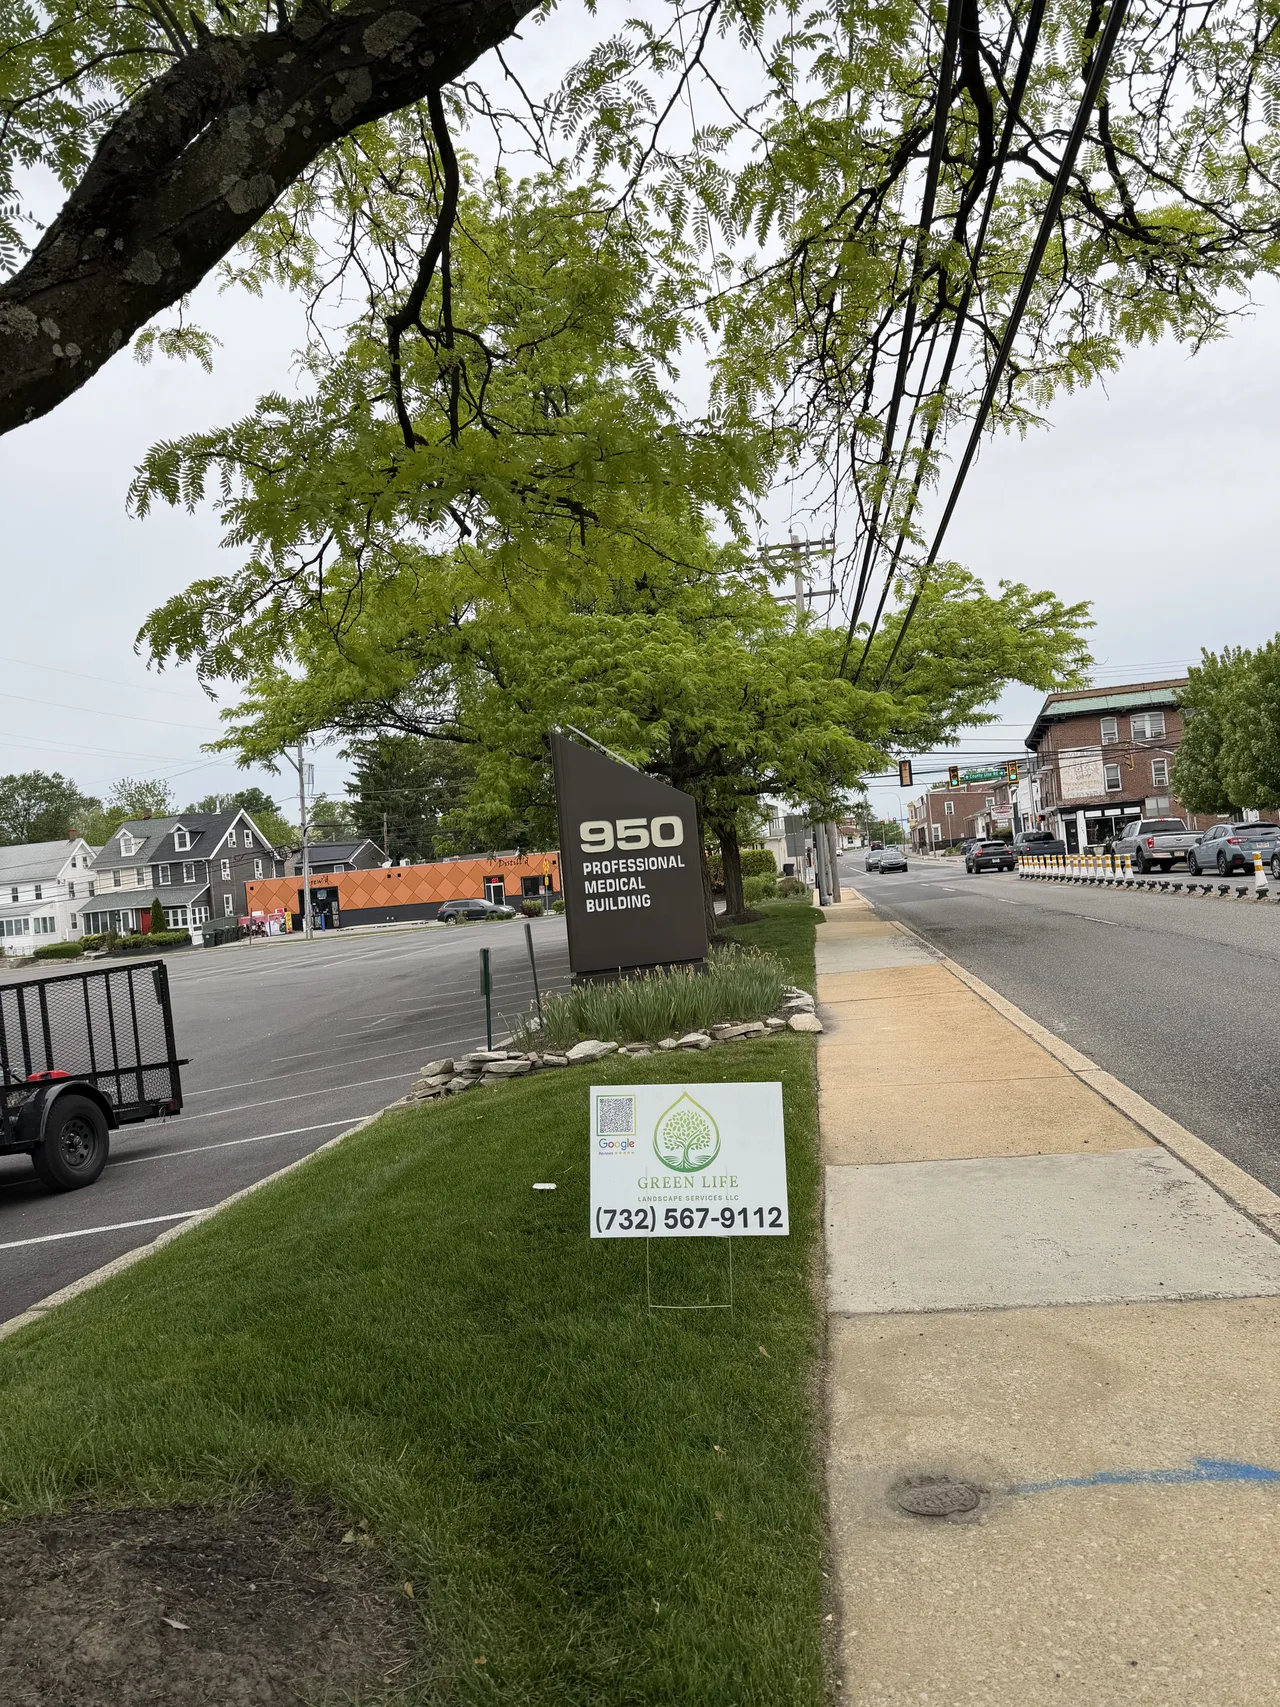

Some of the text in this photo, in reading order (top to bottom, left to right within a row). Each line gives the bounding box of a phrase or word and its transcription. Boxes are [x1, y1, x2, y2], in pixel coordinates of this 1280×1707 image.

[579, 815, 684, 853] 950
[582, 855, 685, 876] PROFESSIONAL
[584, 876, 646, 894] MEDICAL
[586, 894, 651, 913] BUILDING
[598, 1138, 635, 1150] Google
[637, 1175, 739, 1189] GREEN LIFE
[595, 1206, 783, 1233] (732) 567-9112
